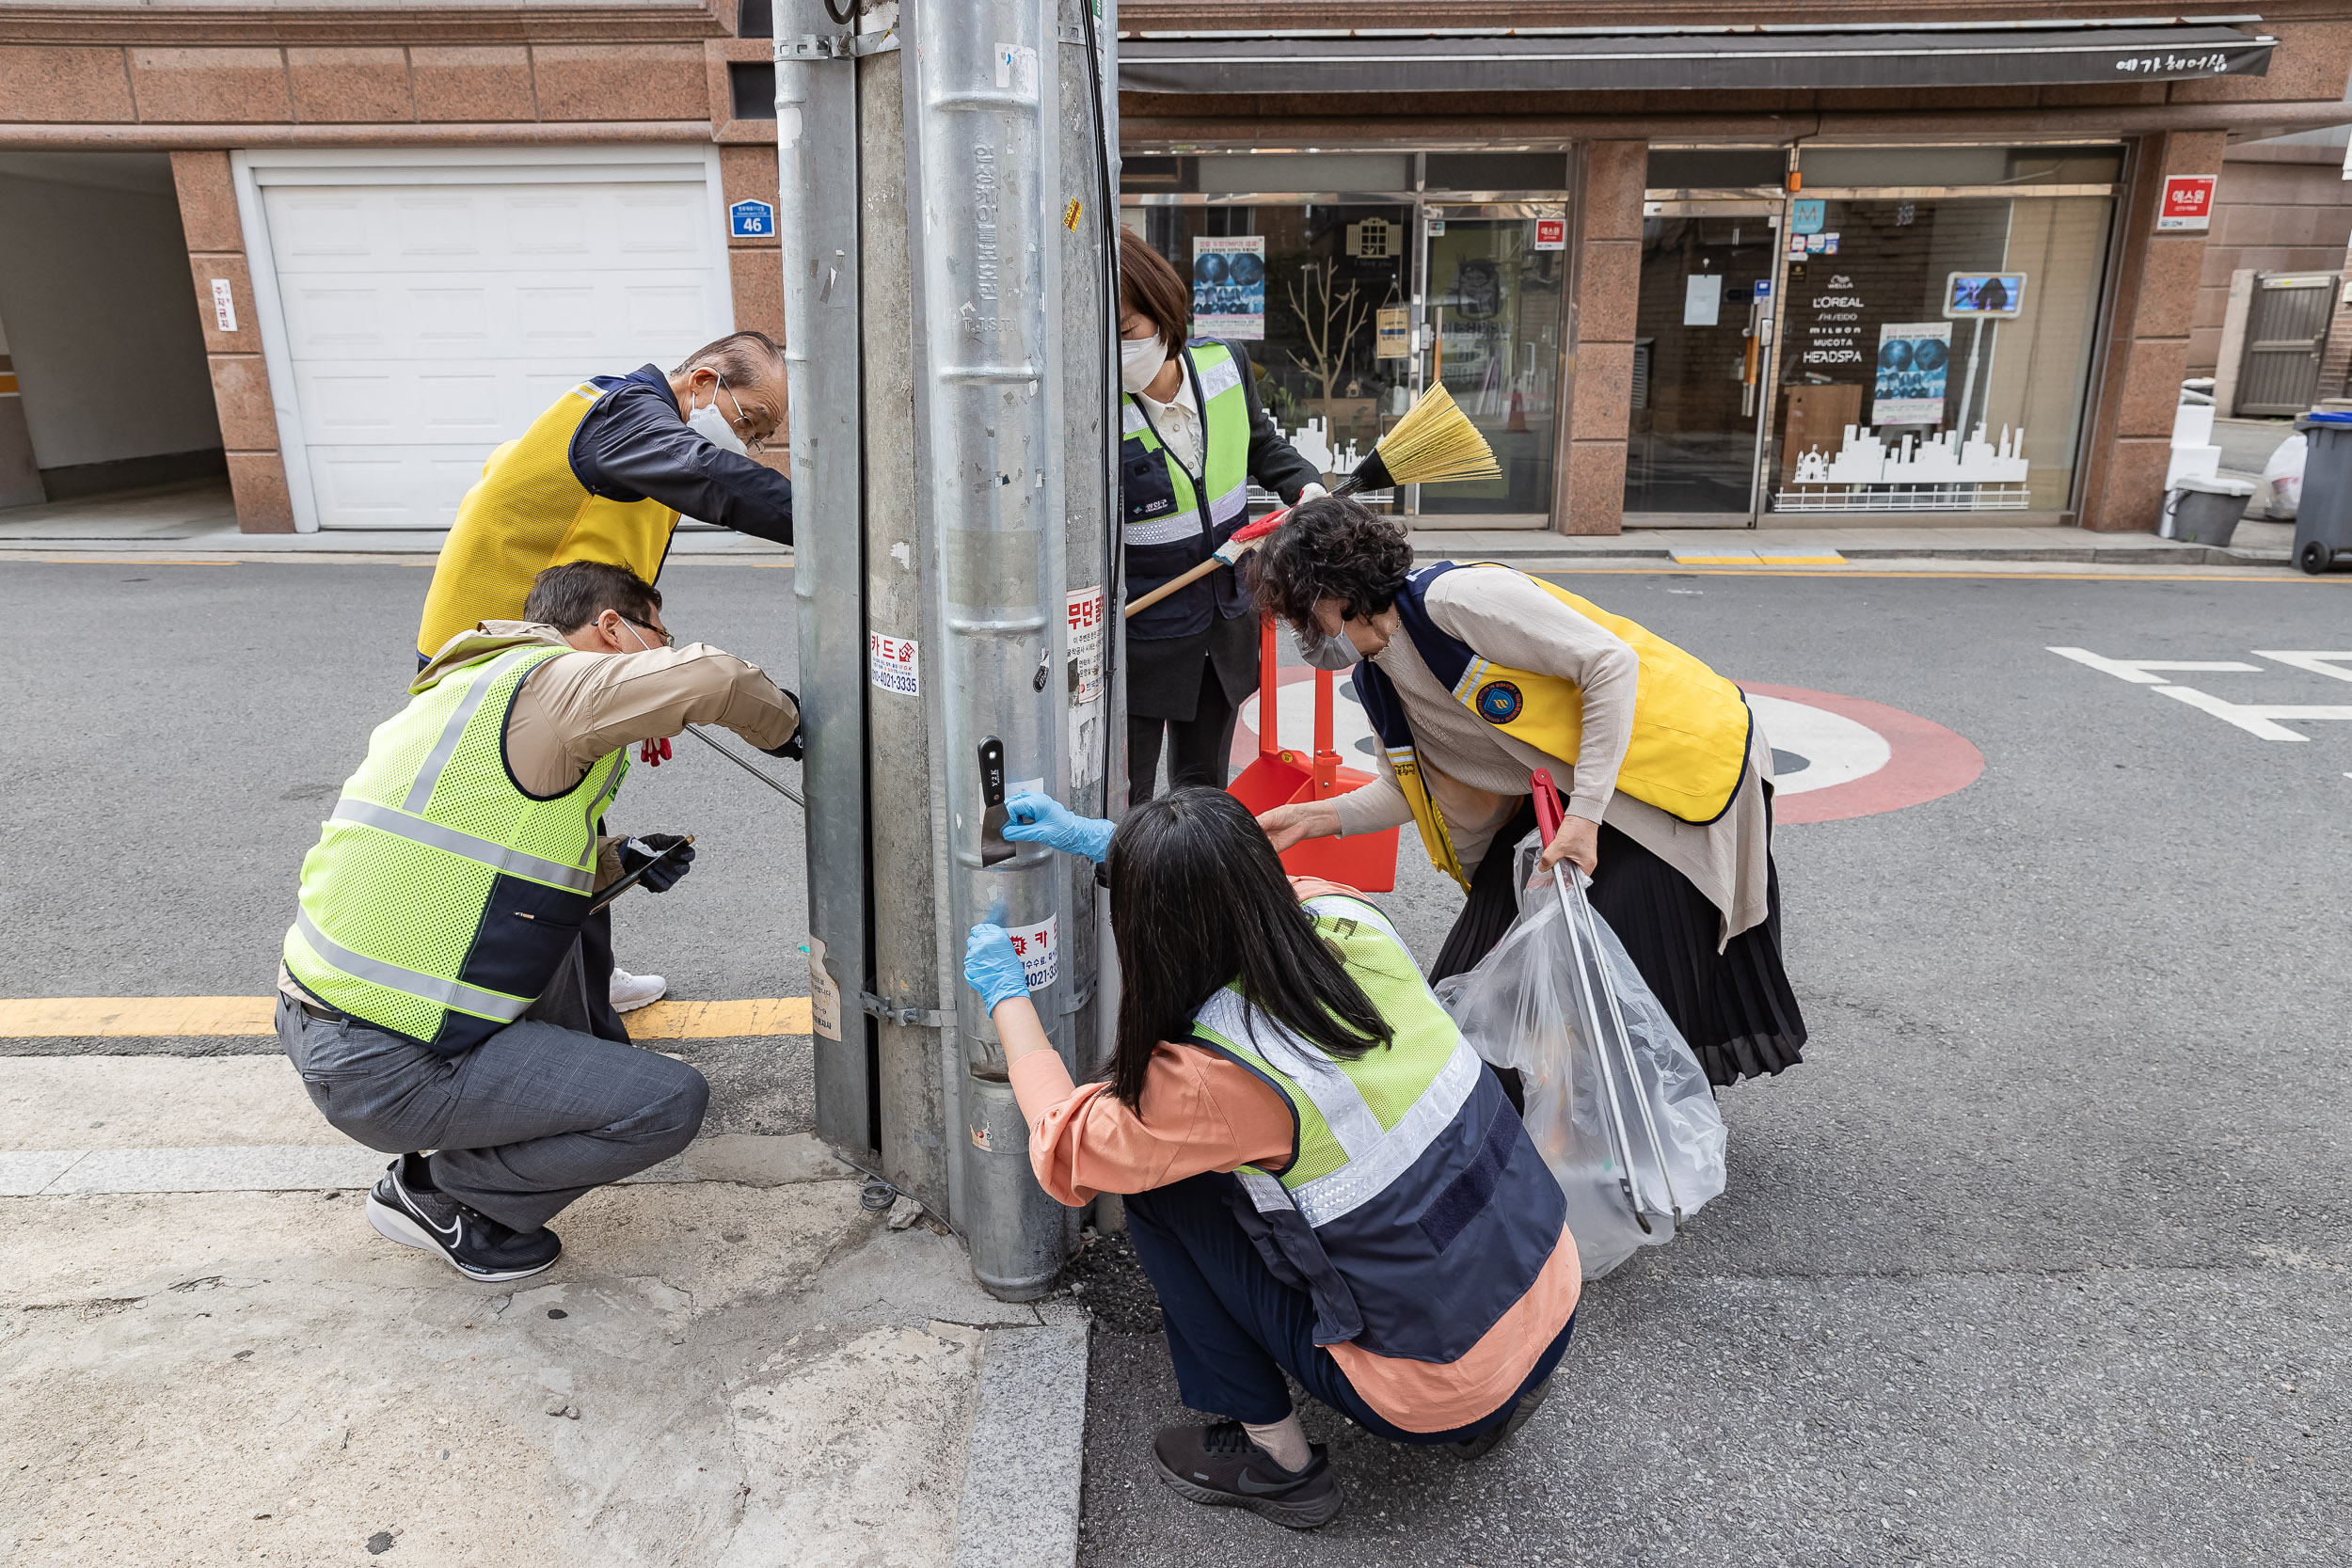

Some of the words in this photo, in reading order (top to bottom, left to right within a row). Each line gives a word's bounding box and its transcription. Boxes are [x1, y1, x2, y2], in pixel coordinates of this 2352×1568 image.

[743, 217, 763, 232] 46
[1813, 339, 1853, 347] MUCOTA
[1803, 350, 1863, 363] HEADSPA
[1069, 600, 1092, 630] 무단
[871, 635, 895, 659] 카드
